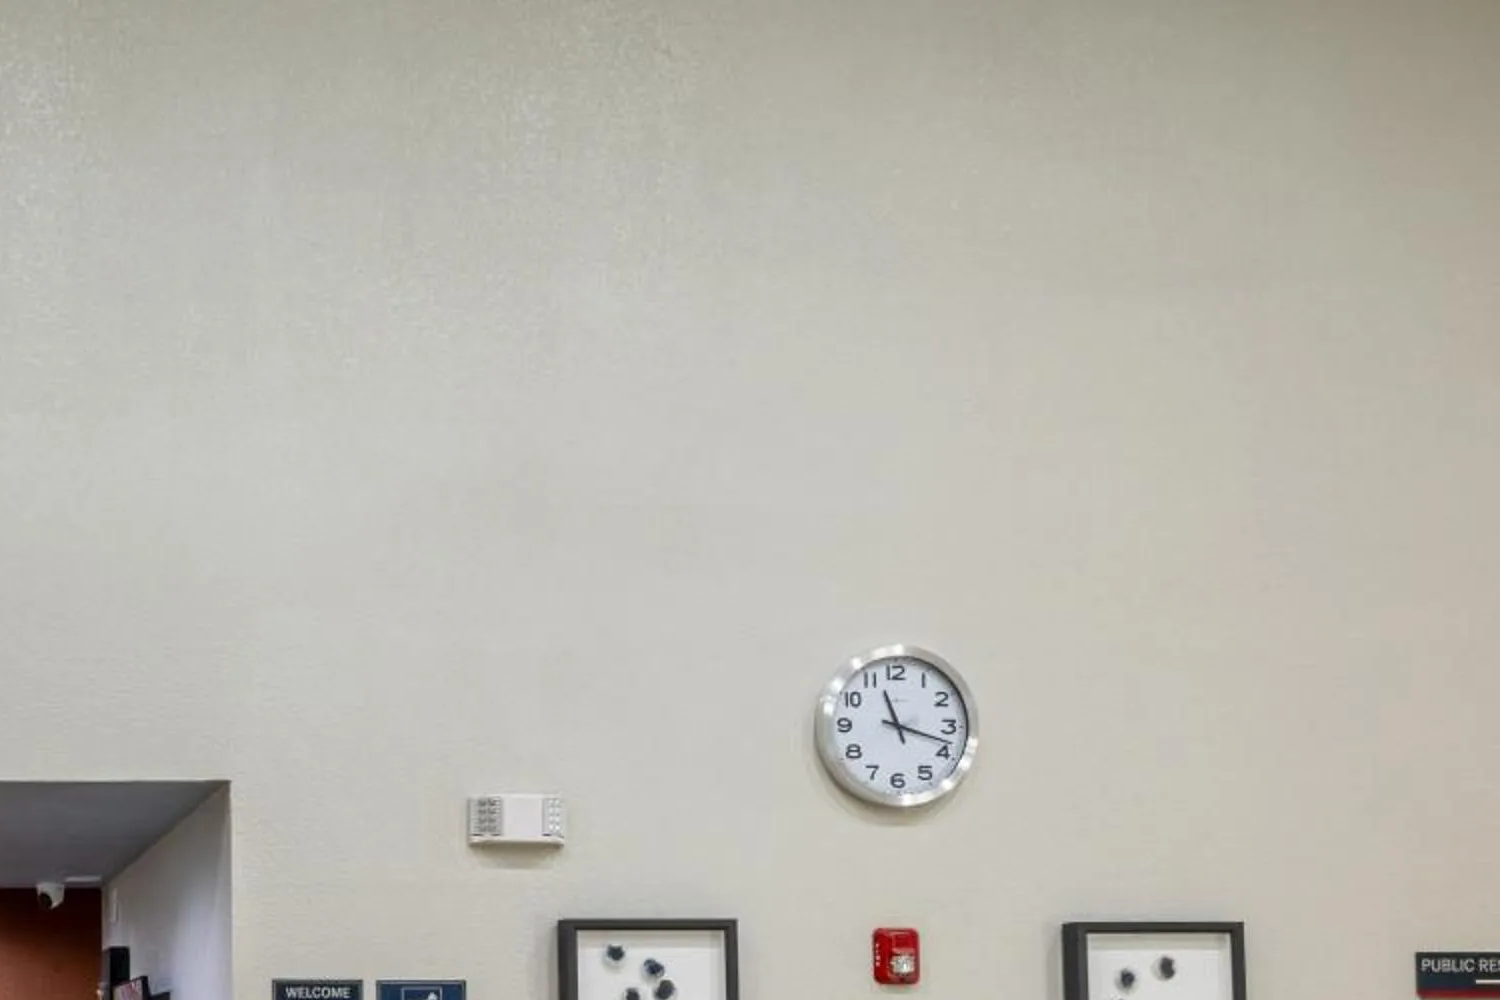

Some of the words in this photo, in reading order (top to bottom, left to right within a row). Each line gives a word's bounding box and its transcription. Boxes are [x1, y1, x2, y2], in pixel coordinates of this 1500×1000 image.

[863, 672, 877, 688] 11
[886, 665, 906, 681] 12
[920, 672, 927, 688] 1
[844, 691, 862, 708] 10
[934, 691, 949, 707] 2
[836, 717, 853, 733] 9
[940, 719, 957, 735] 3
[845, 743, 862, 759] 8
[935, 744, 951, 760] 4
[865, 764, 880, 780] 7
[917, 765, 933, 781] 5
[890, 773, 905, 789] 6
[1421, 957, 1475, 972] PUBLIC
[285, 986, 352, 999] WELCOME
